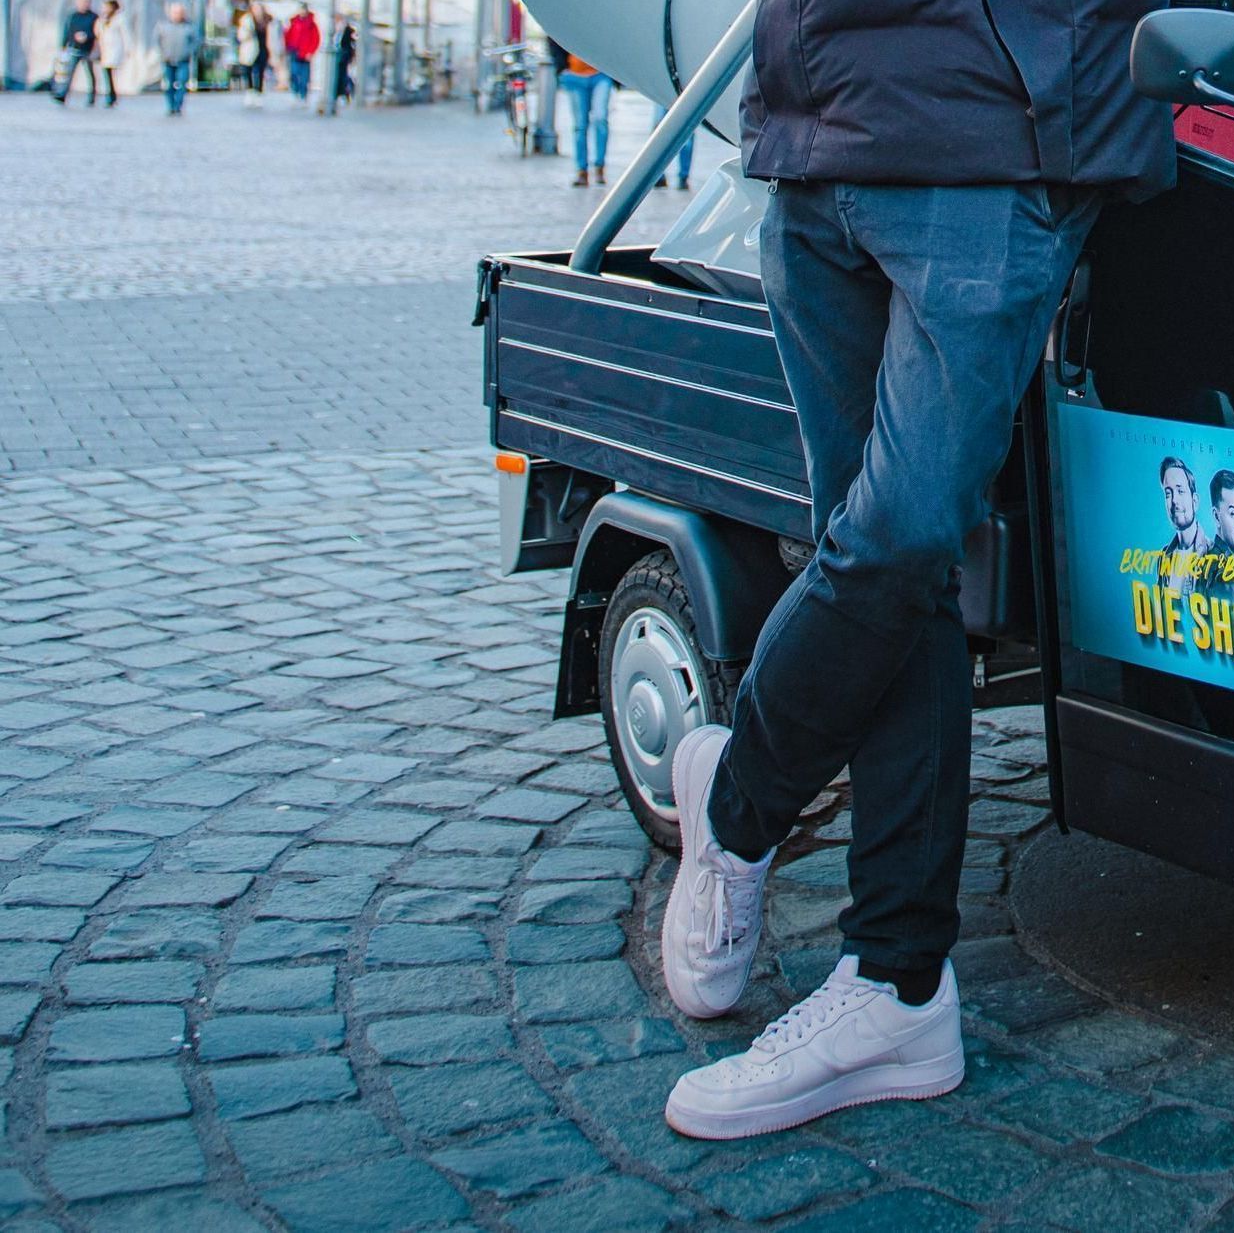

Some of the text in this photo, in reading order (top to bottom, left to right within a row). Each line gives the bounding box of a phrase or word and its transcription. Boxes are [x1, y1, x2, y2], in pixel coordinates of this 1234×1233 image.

[1119, 548, 1218, 580] BRATWURST
[1218, 553, 1225, 568] &
[1132, 580, 1184, 644] DIE
